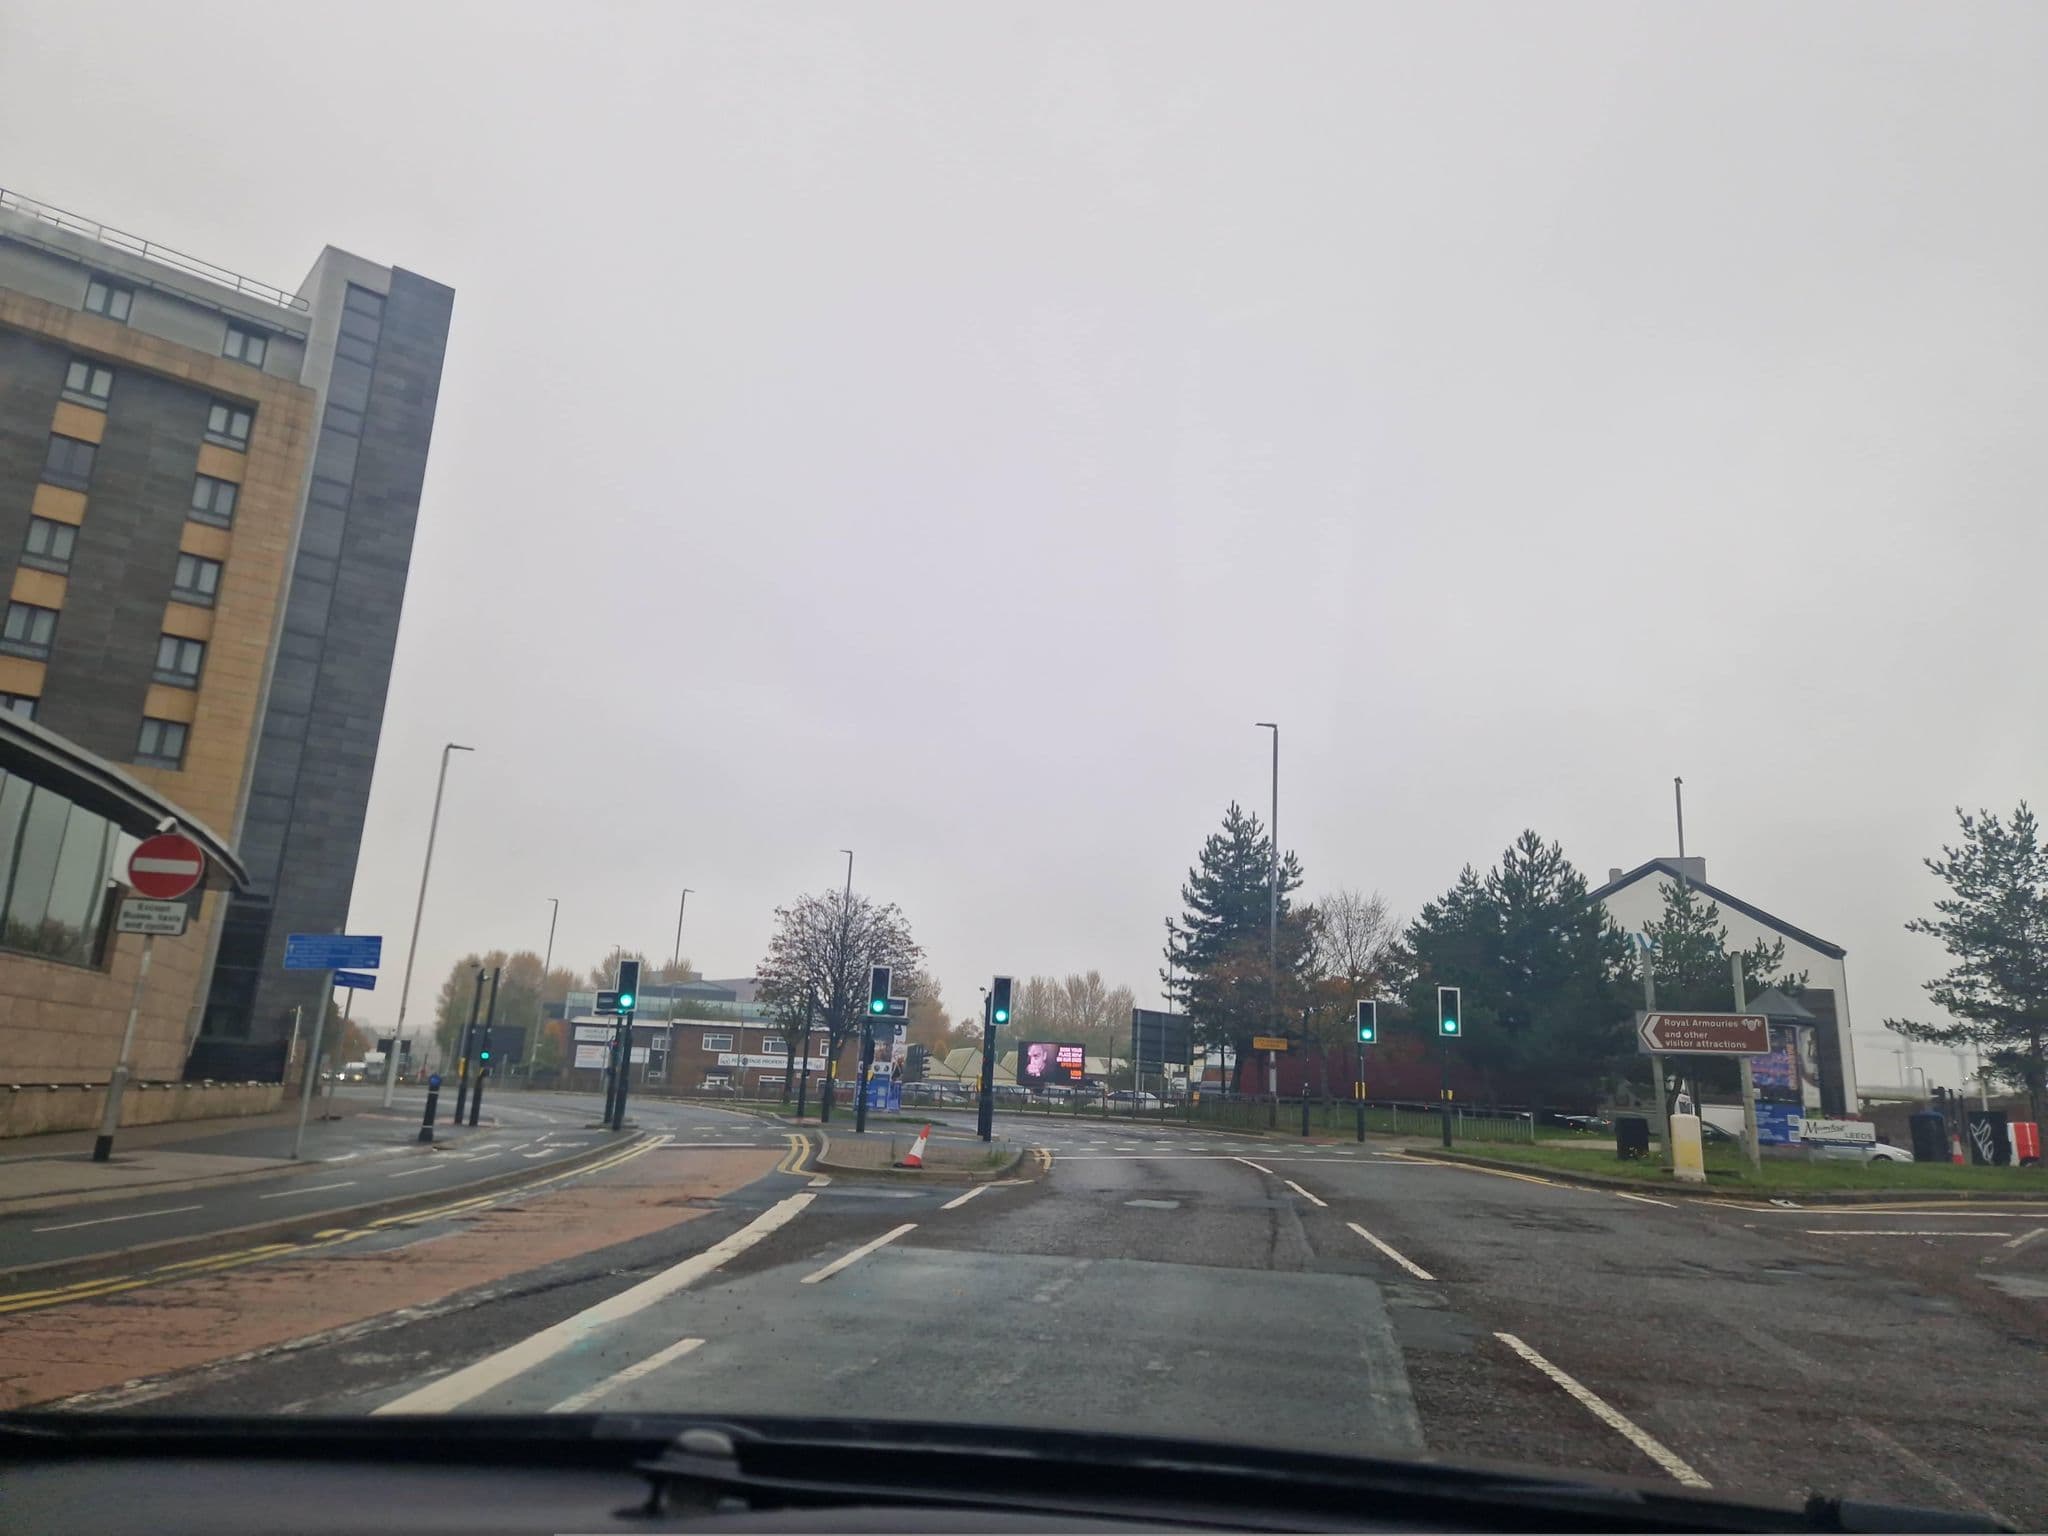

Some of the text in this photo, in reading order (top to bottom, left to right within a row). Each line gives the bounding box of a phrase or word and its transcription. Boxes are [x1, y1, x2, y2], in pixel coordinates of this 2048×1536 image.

[1664, 1019, 1739, 1028] Royal Armouries
[1664, 1031, 1709, 1039] and other
[1665, 1039, 1747, 1049] visitor attractions
